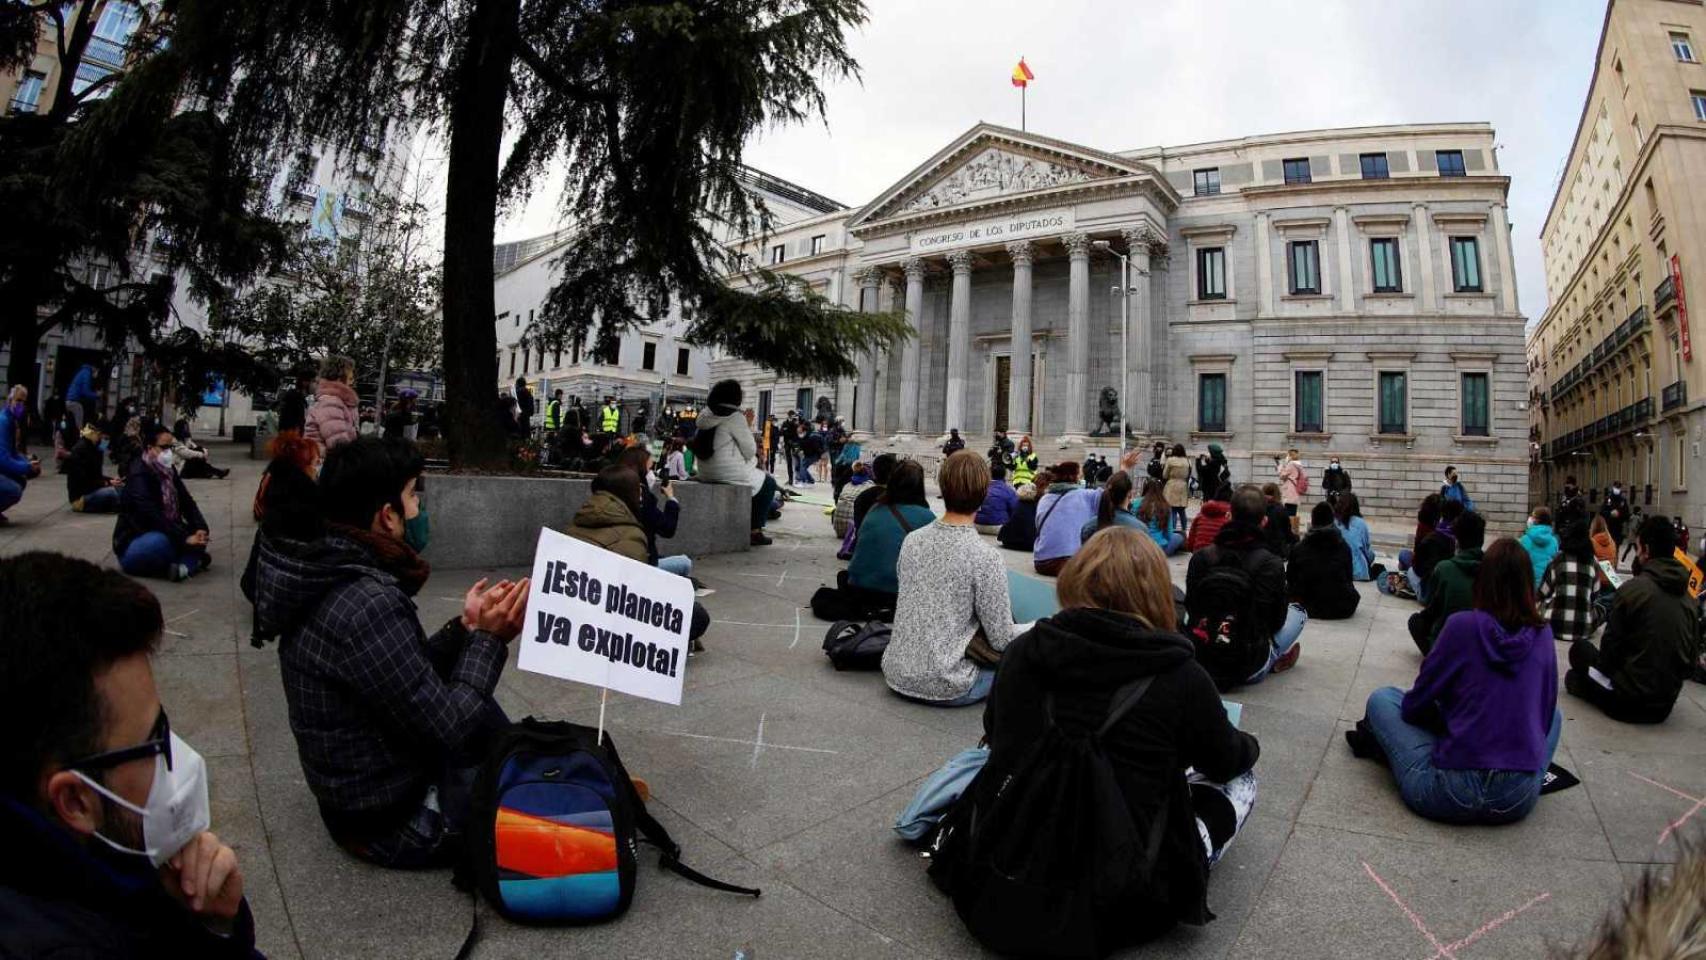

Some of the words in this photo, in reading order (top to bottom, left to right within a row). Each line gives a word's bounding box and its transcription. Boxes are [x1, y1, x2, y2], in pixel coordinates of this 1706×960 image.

[919, 232, 964, 247] CONGRESO
[969, 229, 981, 239] DE
[986, 226, 1003, 236] LOS
[1009, 216, 1063, 233] DIPUTADOS
[541, 559, 602, 606] ¡Este
[605, 583, 684, 635] planeta
[534, 610, 572, 647] ya
[577, 623, 680, 678] explota!
